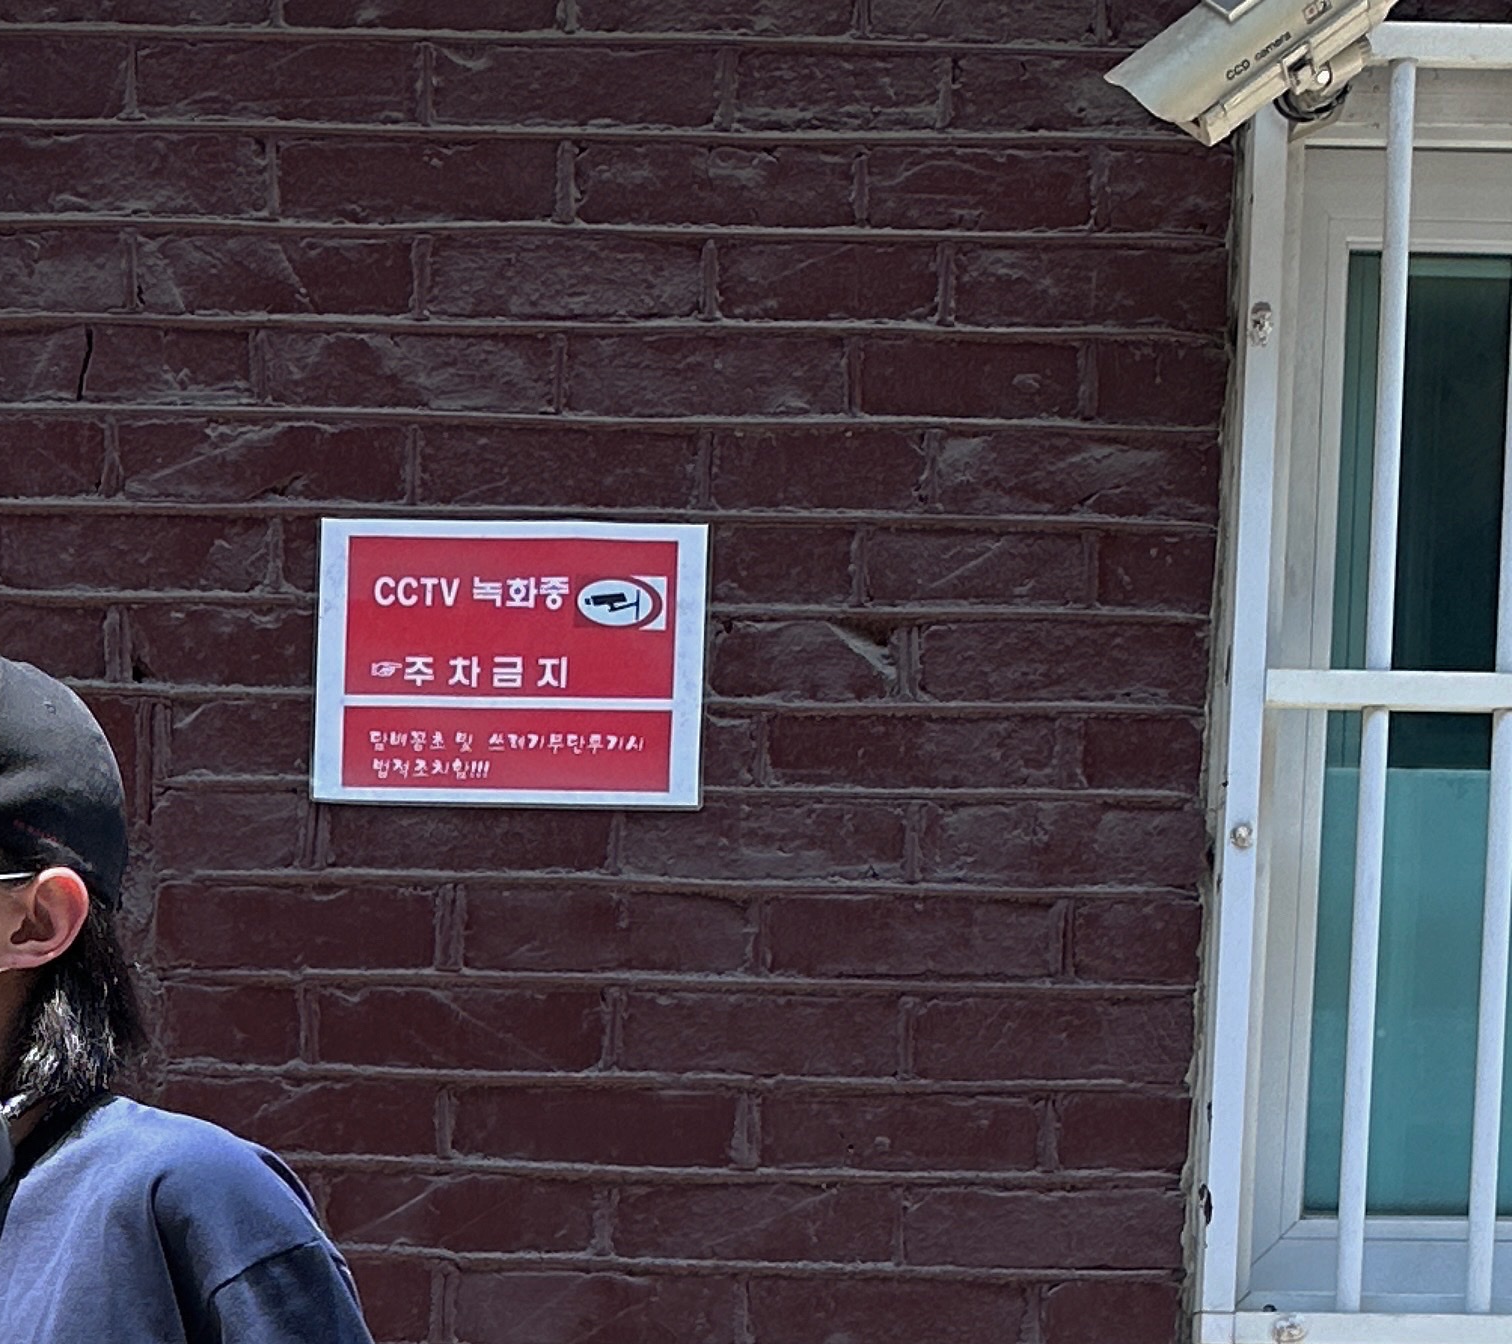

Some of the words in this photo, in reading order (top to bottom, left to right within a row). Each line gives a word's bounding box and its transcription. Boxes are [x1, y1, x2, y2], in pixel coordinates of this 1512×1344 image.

[1226, 58, 1251, 80] CCD
[1254, 31, 1292, 61] camera
[373, 576, 460, 608] CCTV
[472, 576, 570, 610] 녹화중
[368, 730, 446, 751] 담배꽁초
